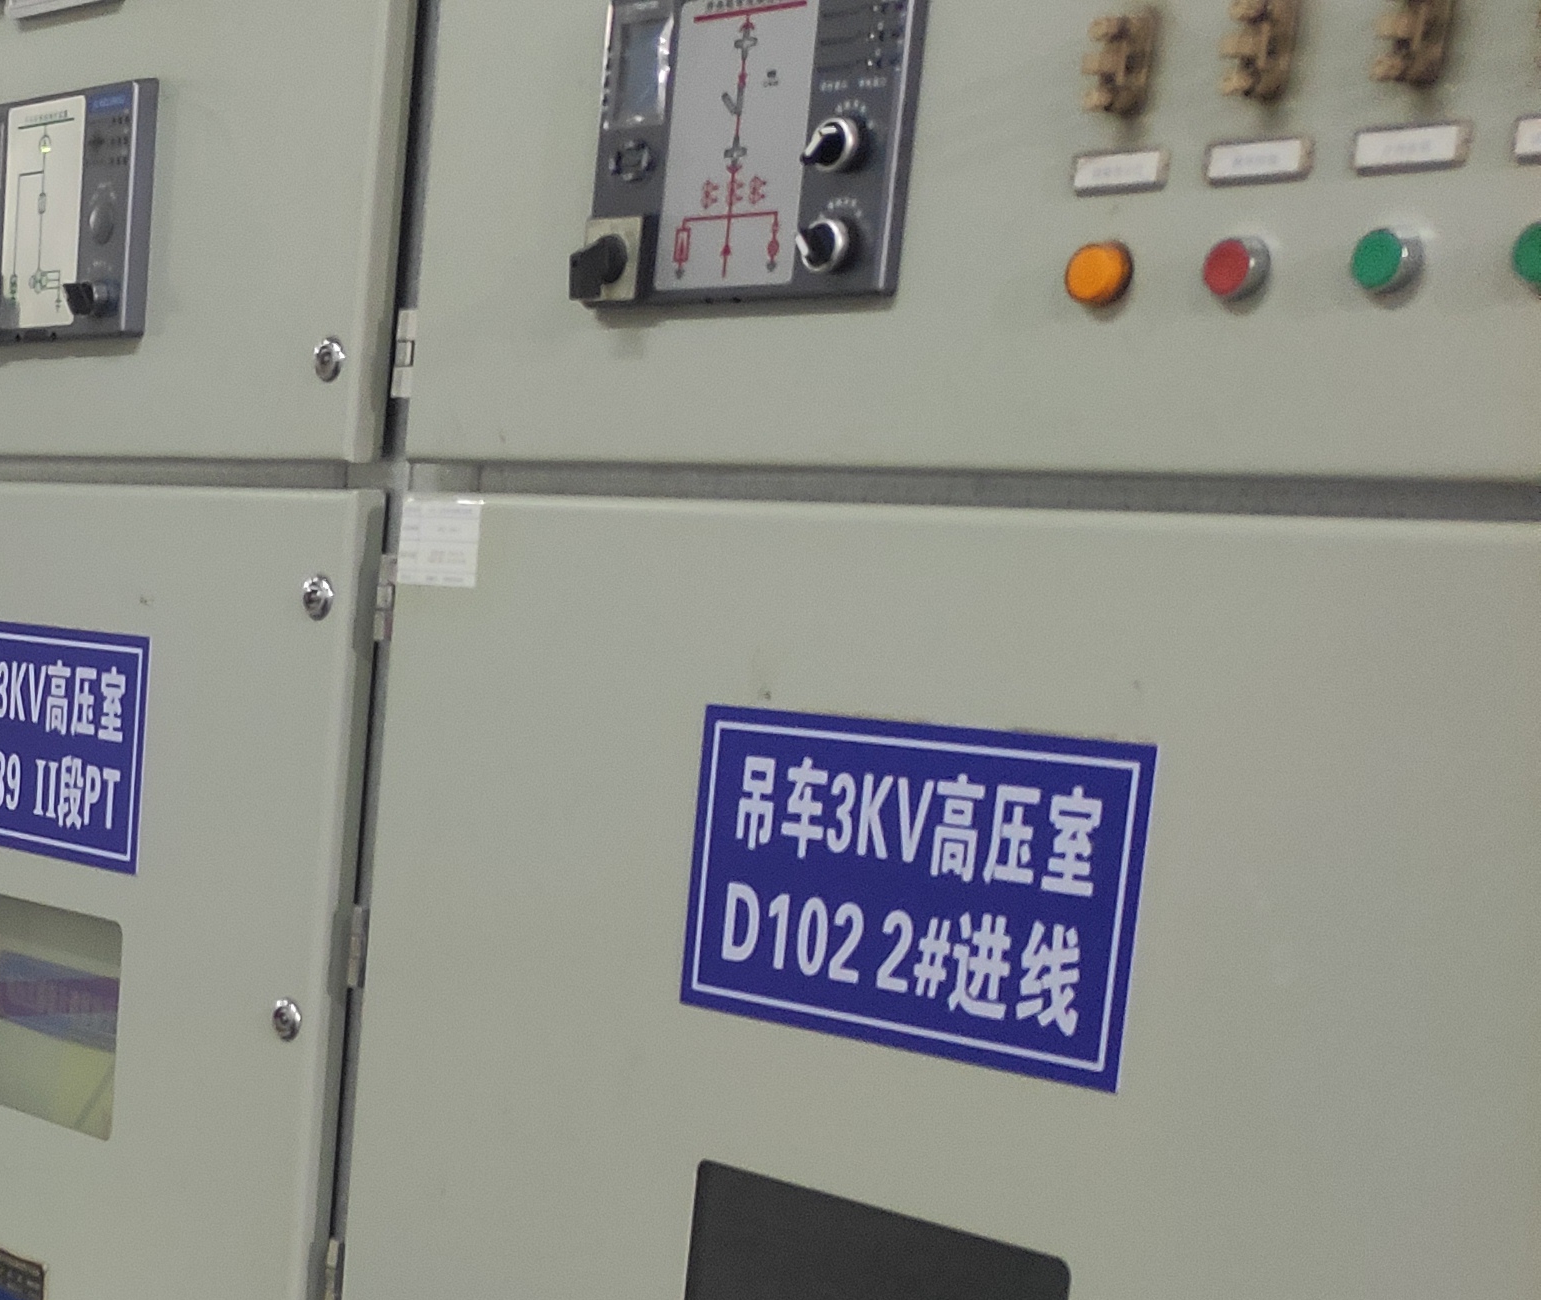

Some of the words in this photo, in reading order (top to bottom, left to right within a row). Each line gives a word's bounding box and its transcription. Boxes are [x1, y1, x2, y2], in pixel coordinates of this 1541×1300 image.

[735, 756, 1103, 897] 吊车3KV高压室
[721, 882, 864, 983] D102
[875, 909, 1081, 1037] 2#进线
